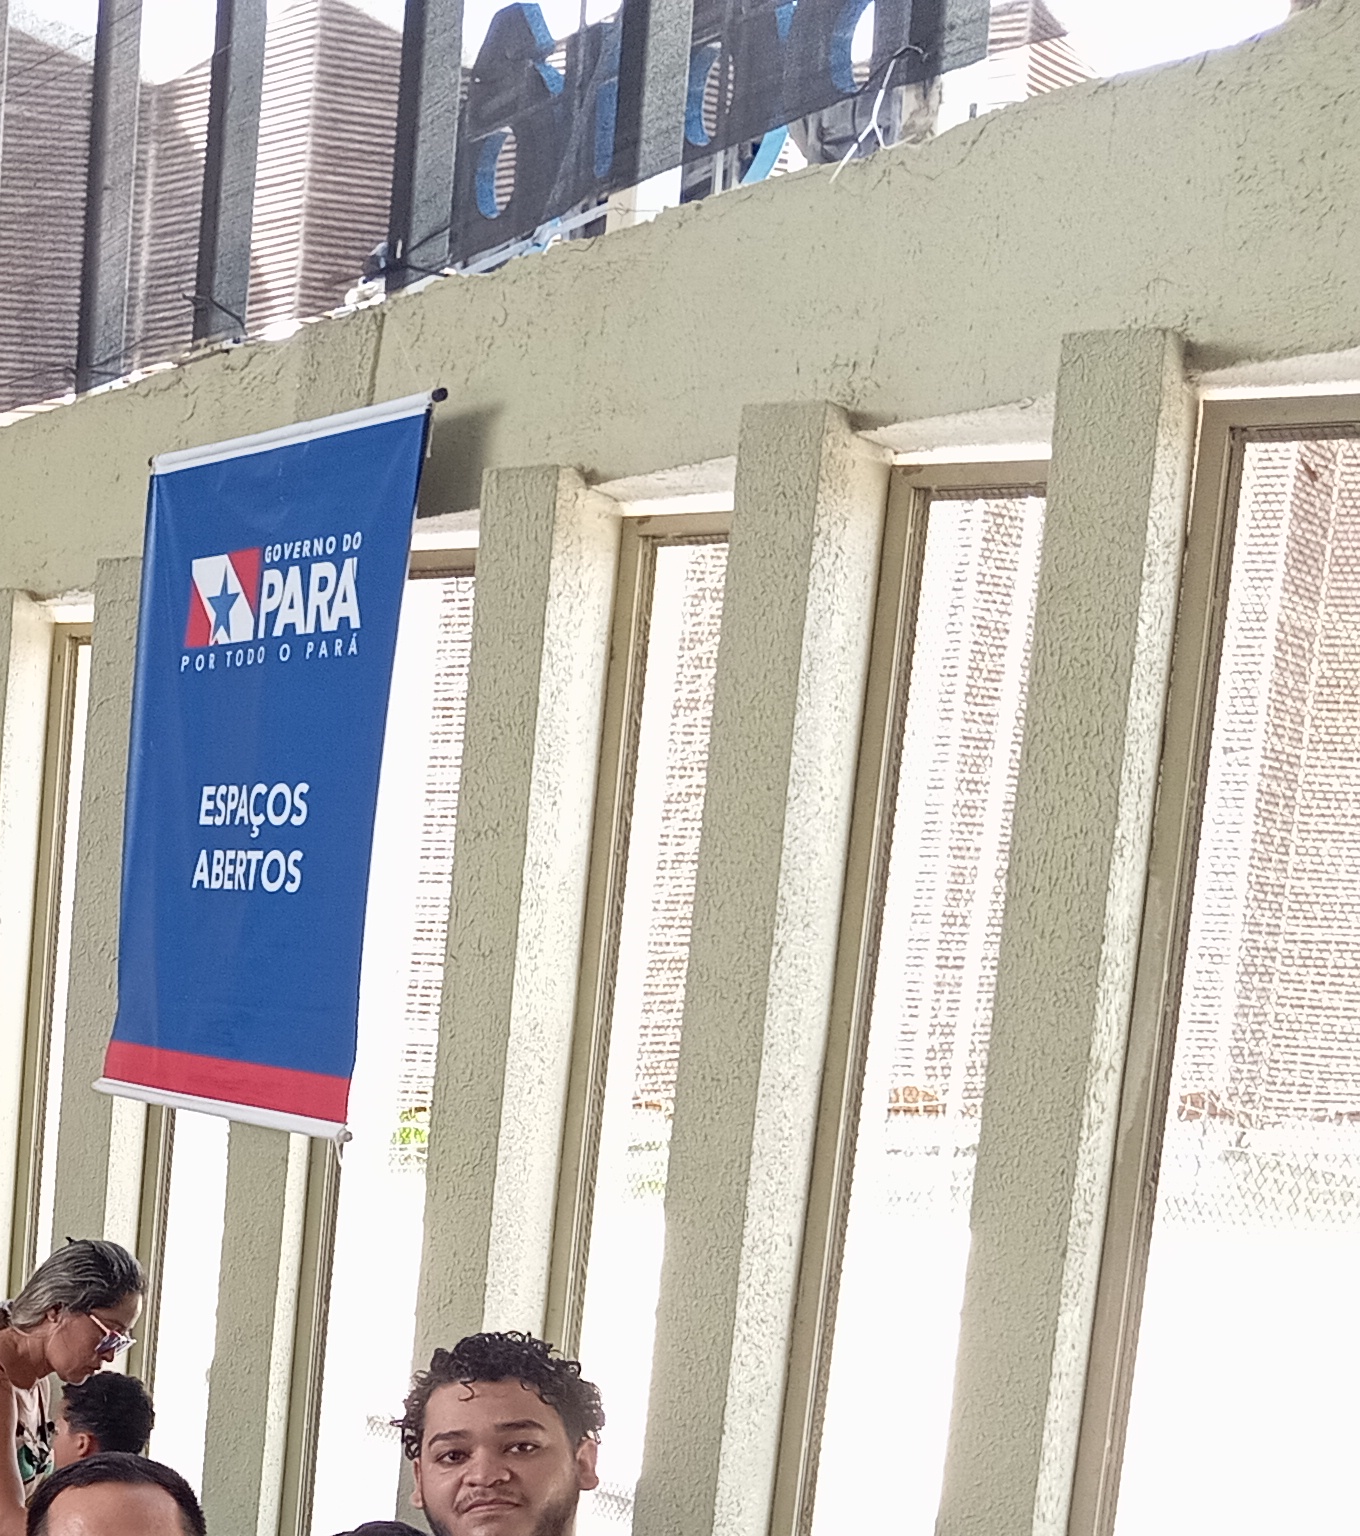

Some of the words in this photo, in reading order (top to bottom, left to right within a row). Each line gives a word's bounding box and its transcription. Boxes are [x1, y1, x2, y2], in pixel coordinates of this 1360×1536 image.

[265, 536, 336, 564] GOVERNO
[342, 531, 362, 551] DO
[257, 557, 361, 639] PARÁ
[180, 653, 215, 673] POR
[226, 646, 265, 667] TODO
[279, 643, 291, 662] O
[305, 632, 358, 660] PARÁ
[199, 782, 310, 838] ESPAÇOS
[191, 849, 304, 893] ABERTOS
